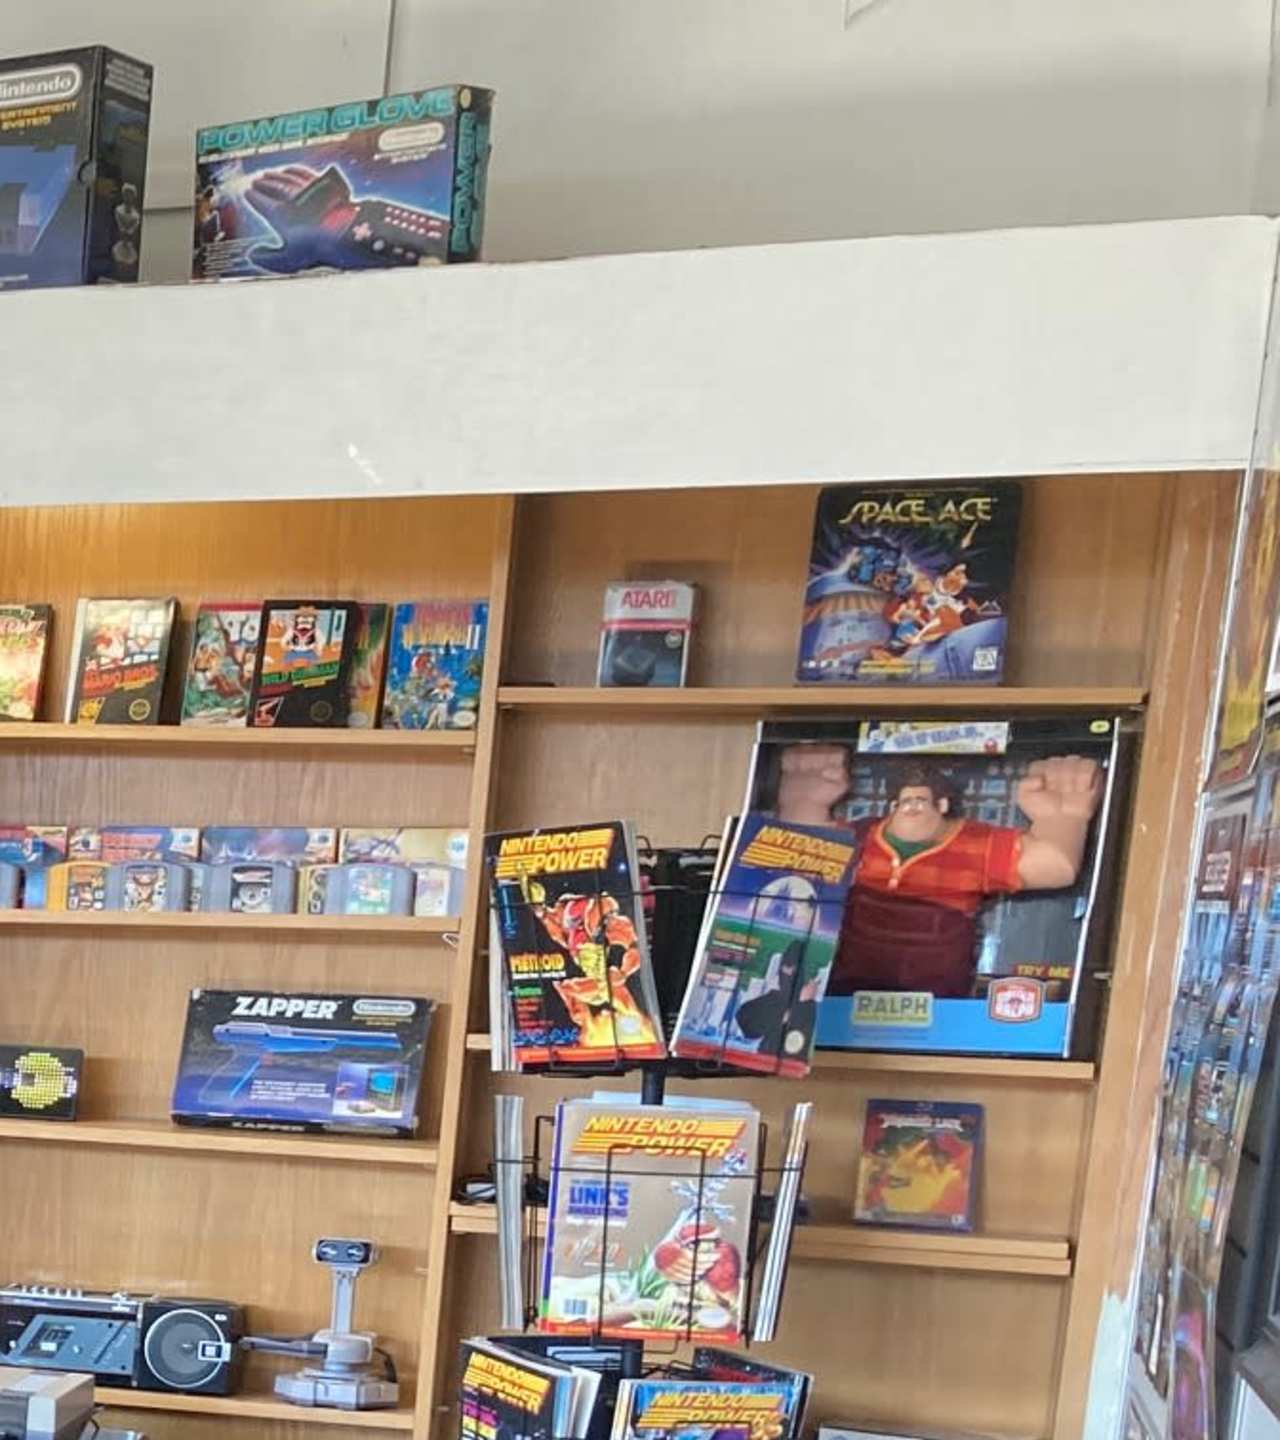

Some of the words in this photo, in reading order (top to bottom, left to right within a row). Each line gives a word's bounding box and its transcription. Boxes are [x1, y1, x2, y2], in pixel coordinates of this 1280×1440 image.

[198, 111, 332, 153] POWER
[332, 88, 454, 134] GLOVE
[839, 499, 932, 524] SPACE
[939, 497, 993, 521] ACE
[621, 588, 677, 609] ATARI
[501, 831, 578, 855] NINTENDO
[532, 848, 609, 874] POWER
[231, 996, 339, 1019] ZAPPER
[855, 996, 928, 1014] RALPH
[585, 1116, 699, 1134] NINTENDO
[629, 1136, 733, 1159] POWER
[653, 1392, 745, 1408] NINTENDO
